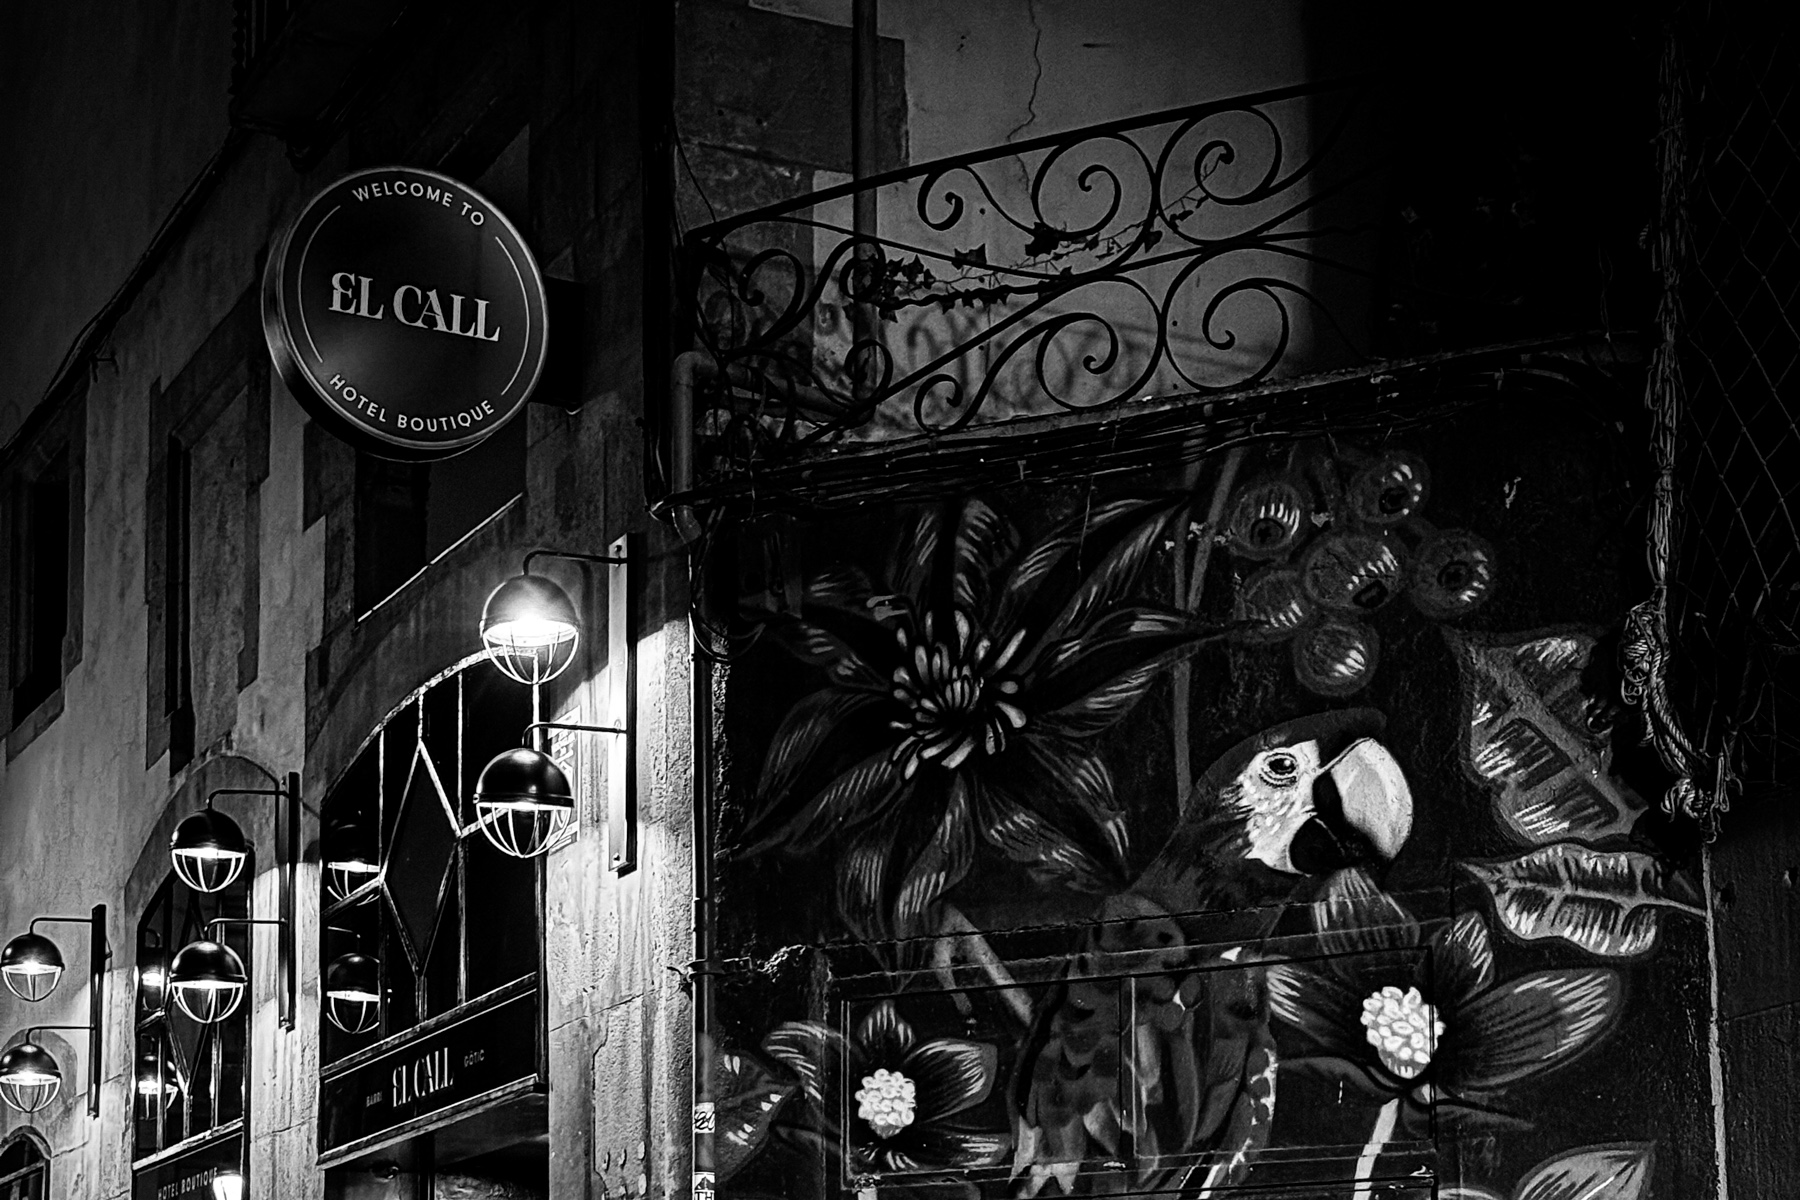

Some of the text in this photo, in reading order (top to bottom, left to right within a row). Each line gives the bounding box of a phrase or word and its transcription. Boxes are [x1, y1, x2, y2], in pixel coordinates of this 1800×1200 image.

[353, 181, 485, 226] WELCOME TO
[328, 272, 500, 342] EL CALL
[329, 374, 494, 432] HOTEL BOUTIQUE
